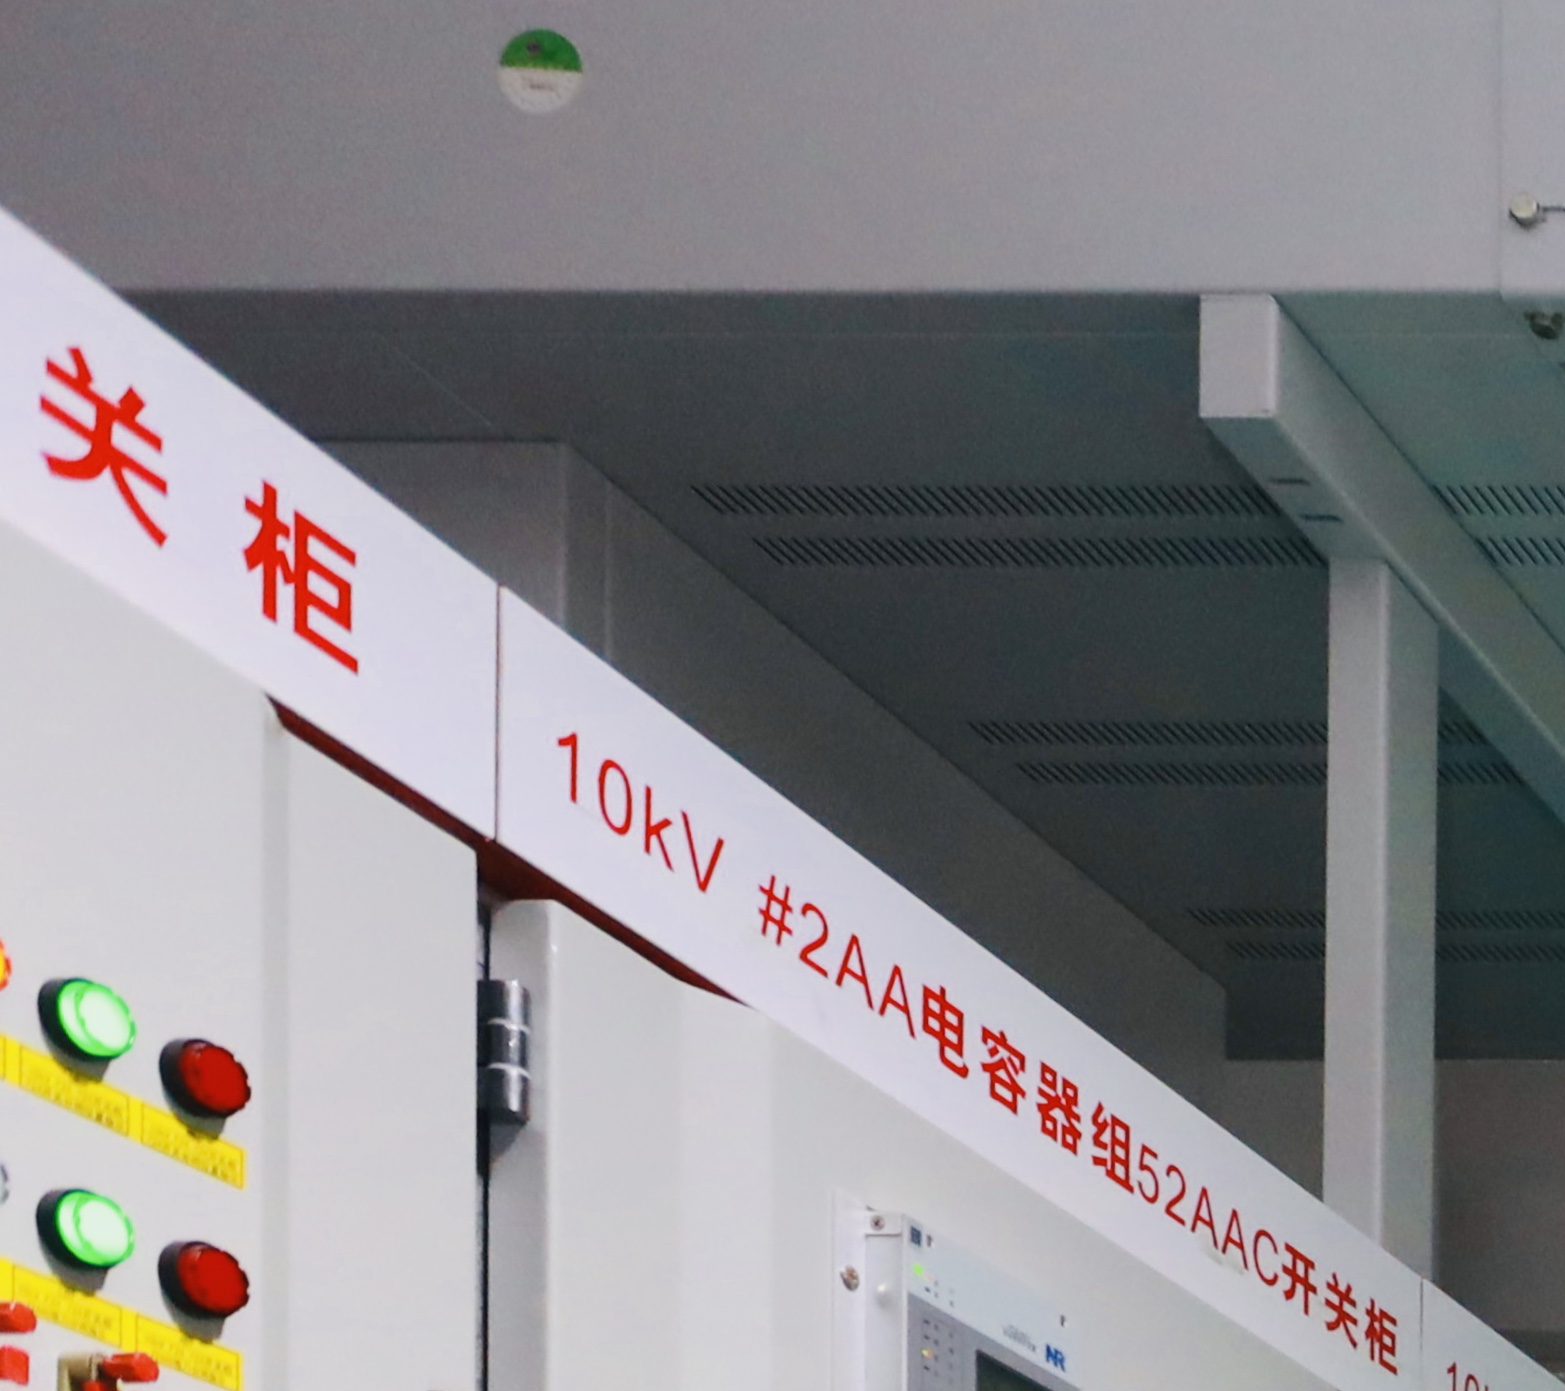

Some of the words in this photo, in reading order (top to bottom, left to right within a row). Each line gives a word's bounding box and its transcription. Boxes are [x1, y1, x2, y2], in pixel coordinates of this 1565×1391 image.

[557, 732, 725, 893] 10kV
[758, 875, 1399, 1376] #2AA电容器组52AAC开关柜
